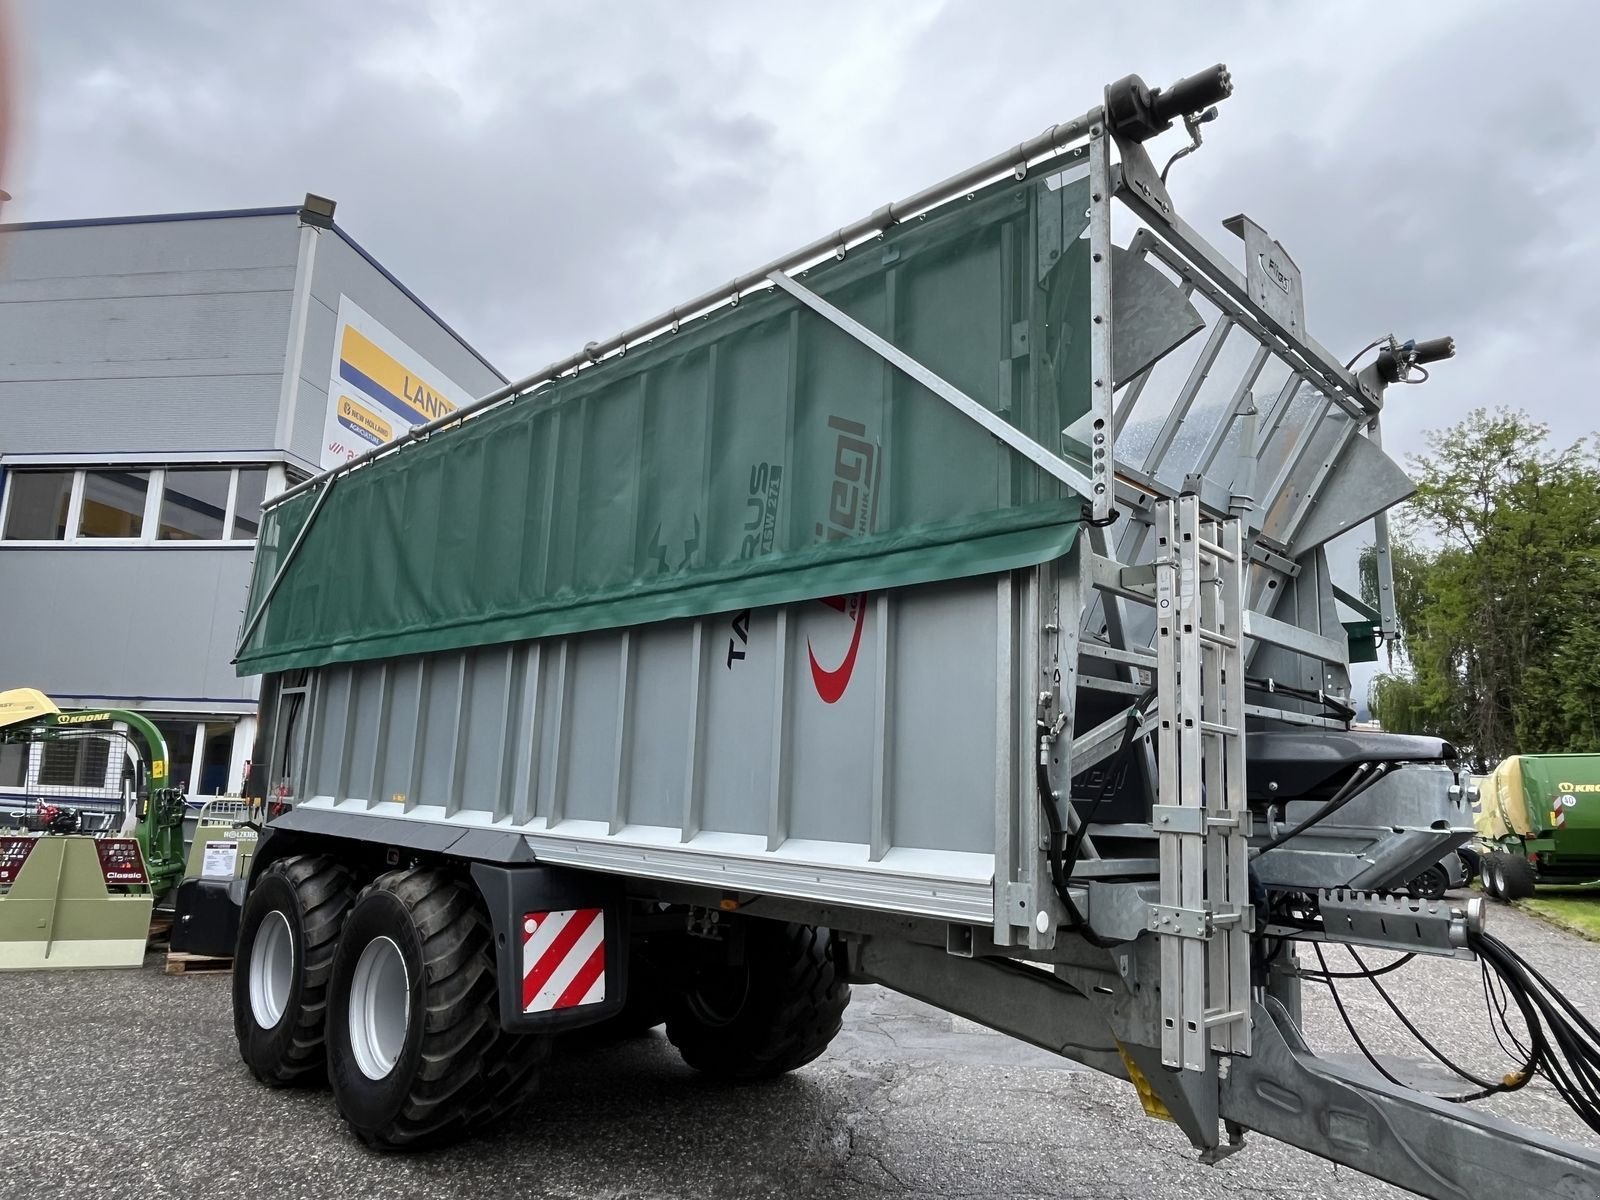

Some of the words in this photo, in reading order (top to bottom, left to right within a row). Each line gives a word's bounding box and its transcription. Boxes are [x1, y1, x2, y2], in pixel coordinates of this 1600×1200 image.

[404, 375, 453, 418] LAND
[351, 410, 365, 422] NEW
[70, 713, 110, 723] KRONE
